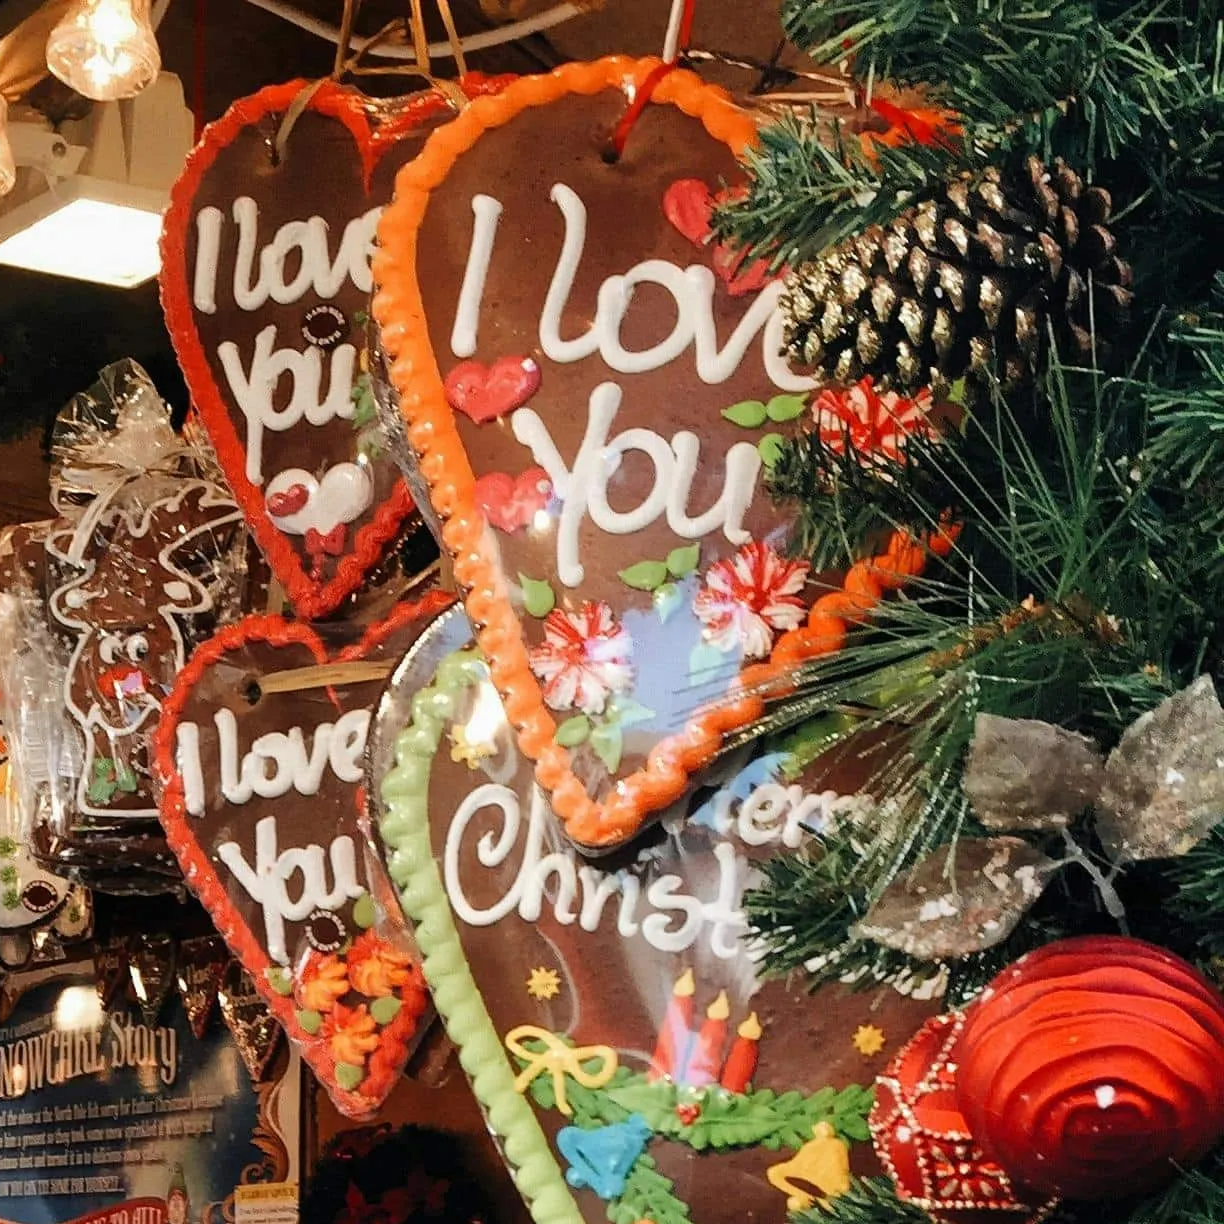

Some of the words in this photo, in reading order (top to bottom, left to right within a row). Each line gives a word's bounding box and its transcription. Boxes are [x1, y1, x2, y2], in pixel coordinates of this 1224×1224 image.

[194, 206, 223, 314] I
[233, 196, 384, 311] love
[451, 194, 503, 358] I
[218, 325, 356, 485] You
[512, 382, 760, 587] You
[176, 721, 205, 817] I
[213, 707, 371, 806] love
[218, 816, 366, 970] You
[444, 784, 746, 960] Christ
[110, 1011, 177, 1085] Story
